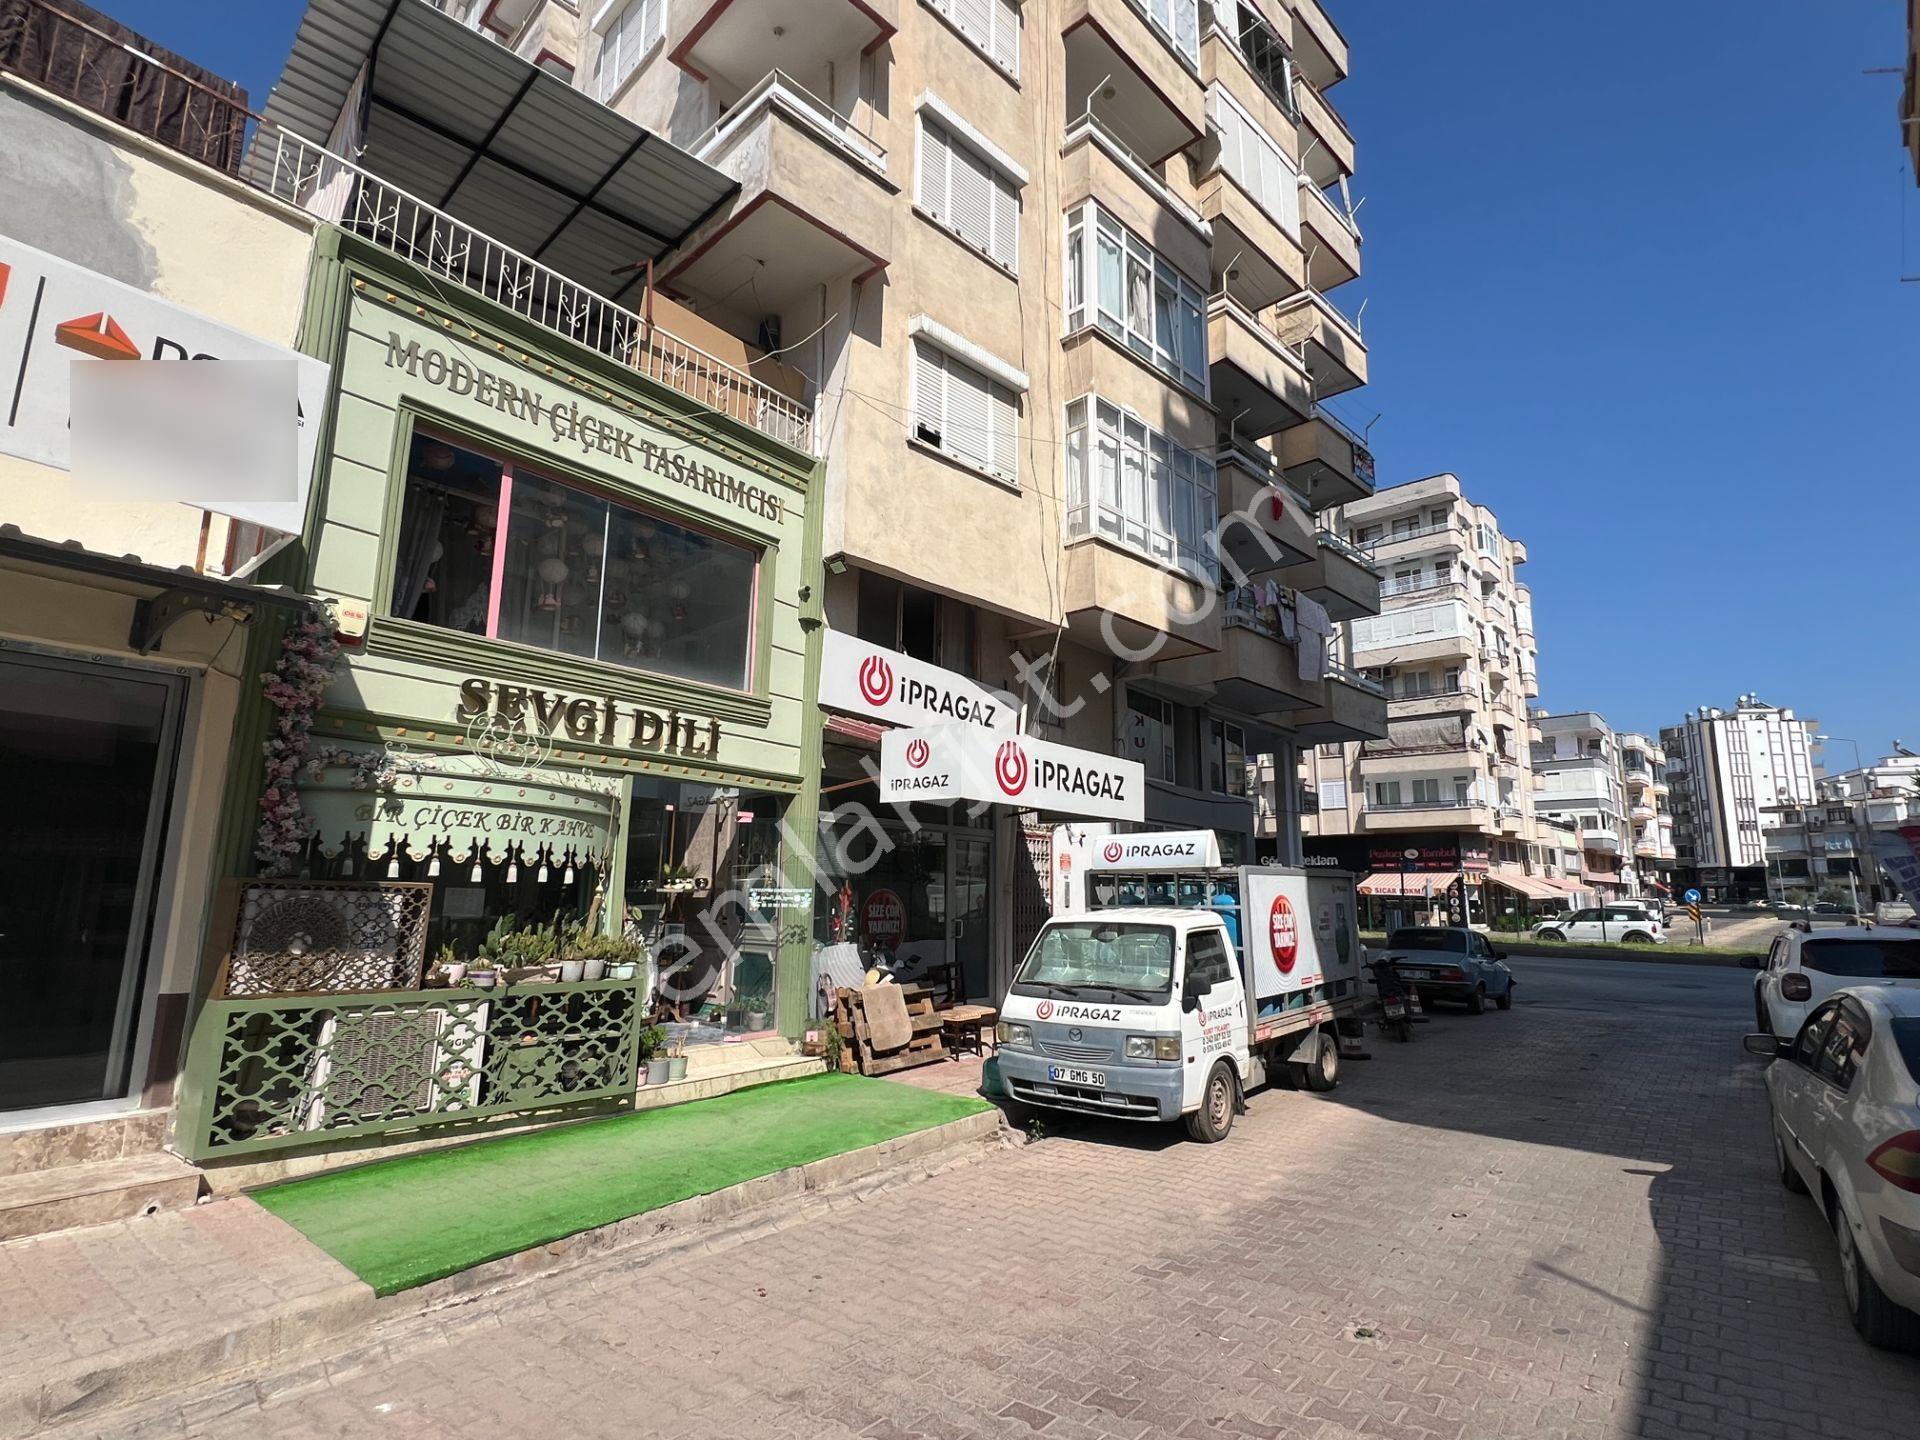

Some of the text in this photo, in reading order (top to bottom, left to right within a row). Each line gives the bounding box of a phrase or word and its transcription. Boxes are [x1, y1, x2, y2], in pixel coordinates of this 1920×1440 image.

[384, 331, 541, 426] MODERN
[549, 401, 634, 463] ÇİÇEK
[640, 439, 786, 525] TASARIMCISI
[459, 678, 721, 753] SEVGİ DİLİ
[413, 804, 492, 833] ÇİÇEK
[497, 812, 537, 836] BİR
[539, 817, 596, 839] KAHVE
[1304, 856, 1338, 866] eklam
[1054, 1067, 1104, 1085] 07 GMG 50
